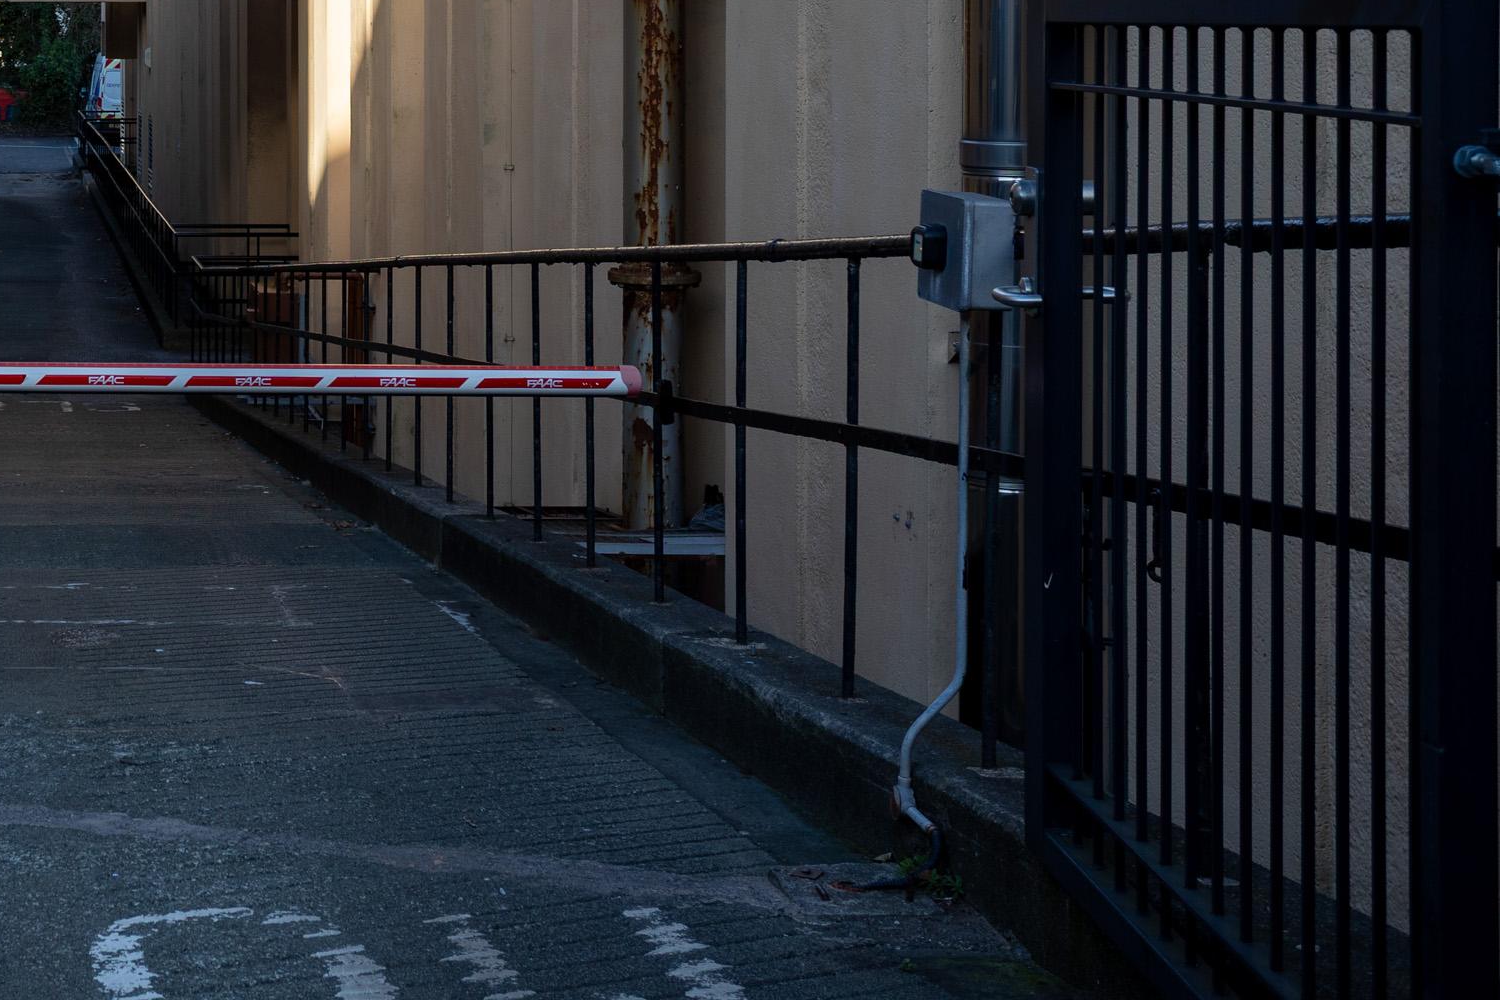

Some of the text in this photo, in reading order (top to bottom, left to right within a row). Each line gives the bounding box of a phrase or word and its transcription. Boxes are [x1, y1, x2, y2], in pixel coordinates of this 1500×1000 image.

[89, 376, 124, 384] FAAC
[236, 377, 271, 385] FAAC
[380, 378, 416, 386] FAAC
[527, 379, 563, 387] FAAC
